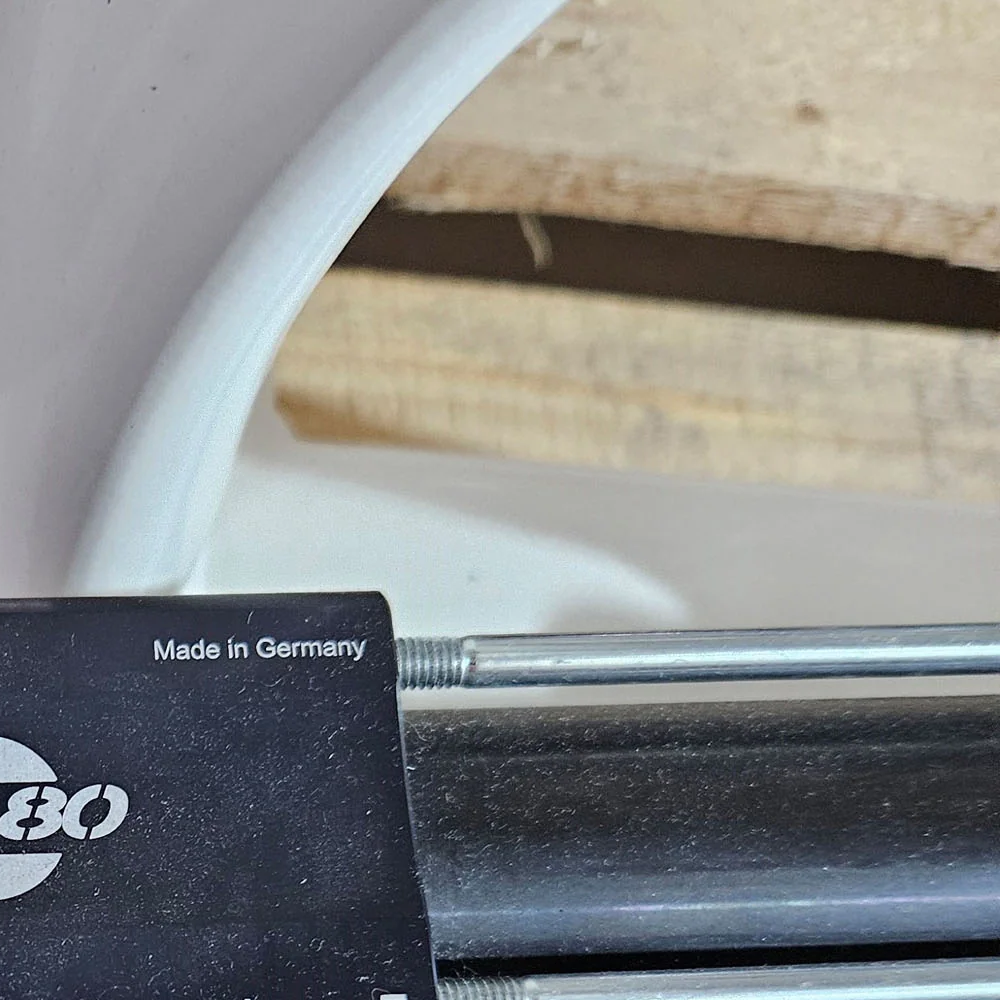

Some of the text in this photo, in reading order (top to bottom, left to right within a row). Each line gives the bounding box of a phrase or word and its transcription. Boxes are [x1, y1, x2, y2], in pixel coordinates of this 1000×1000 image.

[153, 637, 367, 663] Made in Germany
